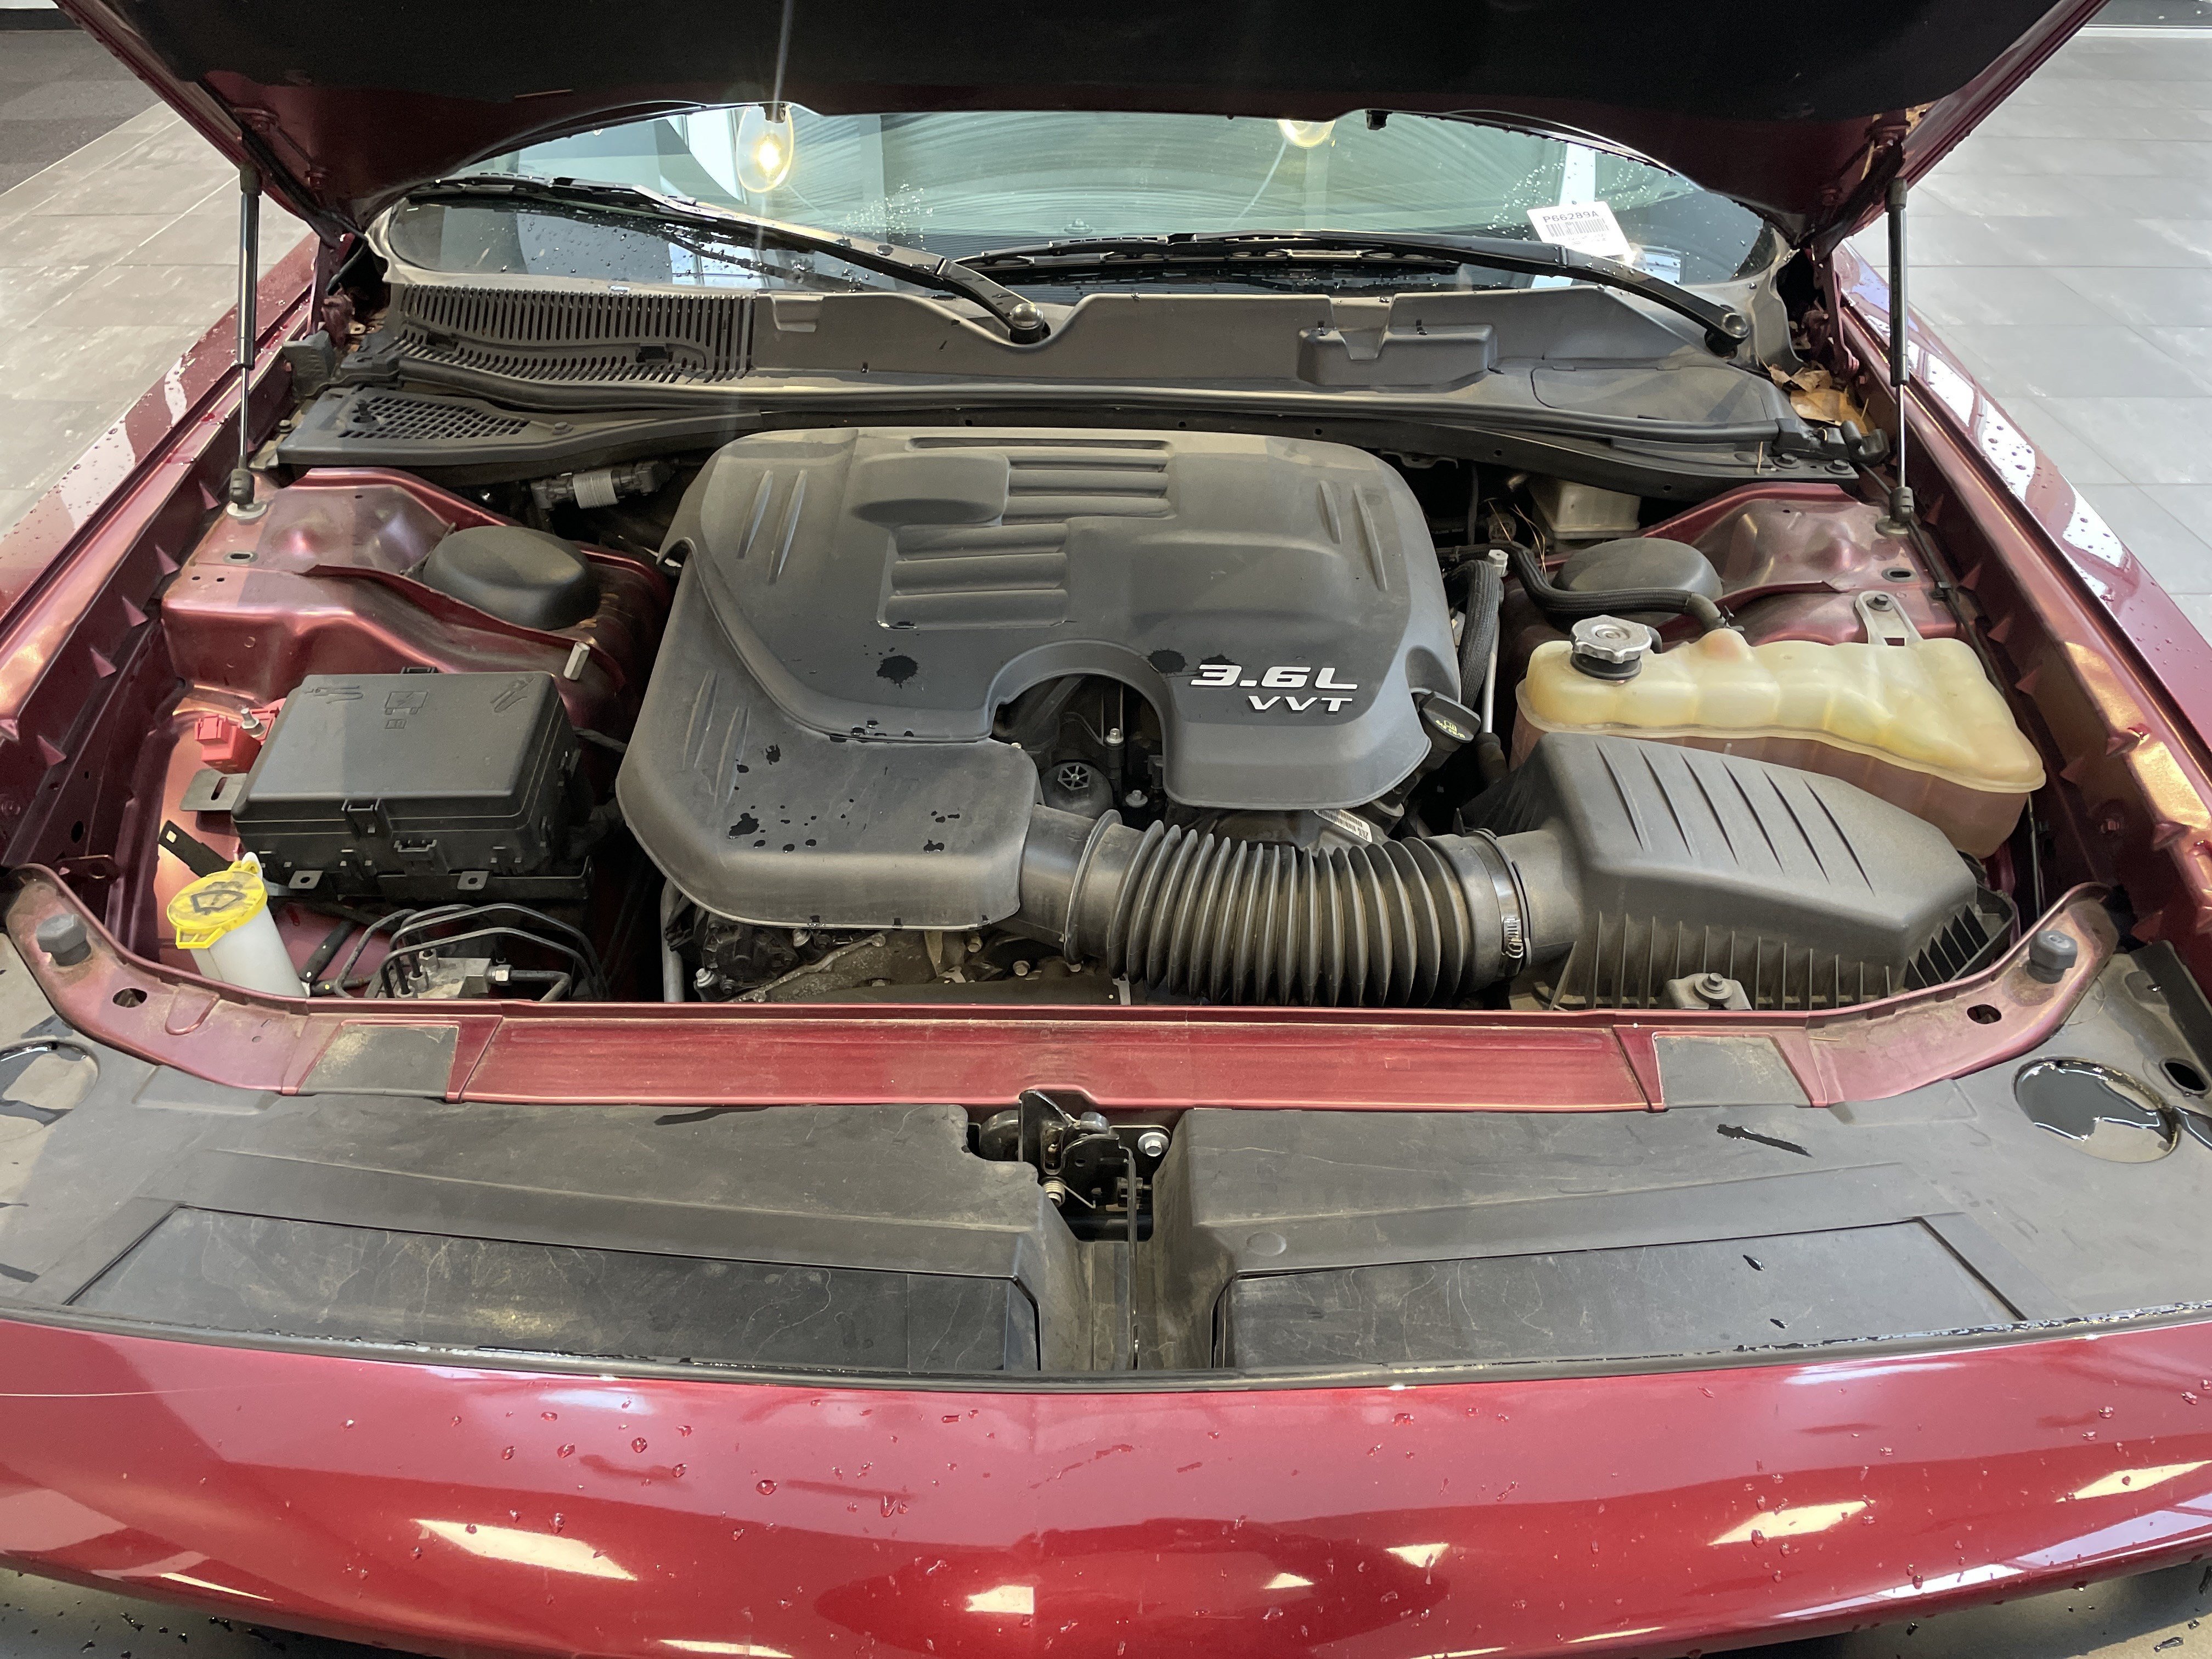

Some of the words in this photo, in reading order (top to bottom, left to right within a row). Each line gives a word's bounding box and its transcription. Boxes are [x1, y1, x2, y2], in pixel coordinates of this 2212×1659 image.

[1542, 210, 1599, 223] P66289A
[1190, 664, 1358, 690] 3.6L
[1248, 695, 1353, 712] VVT
